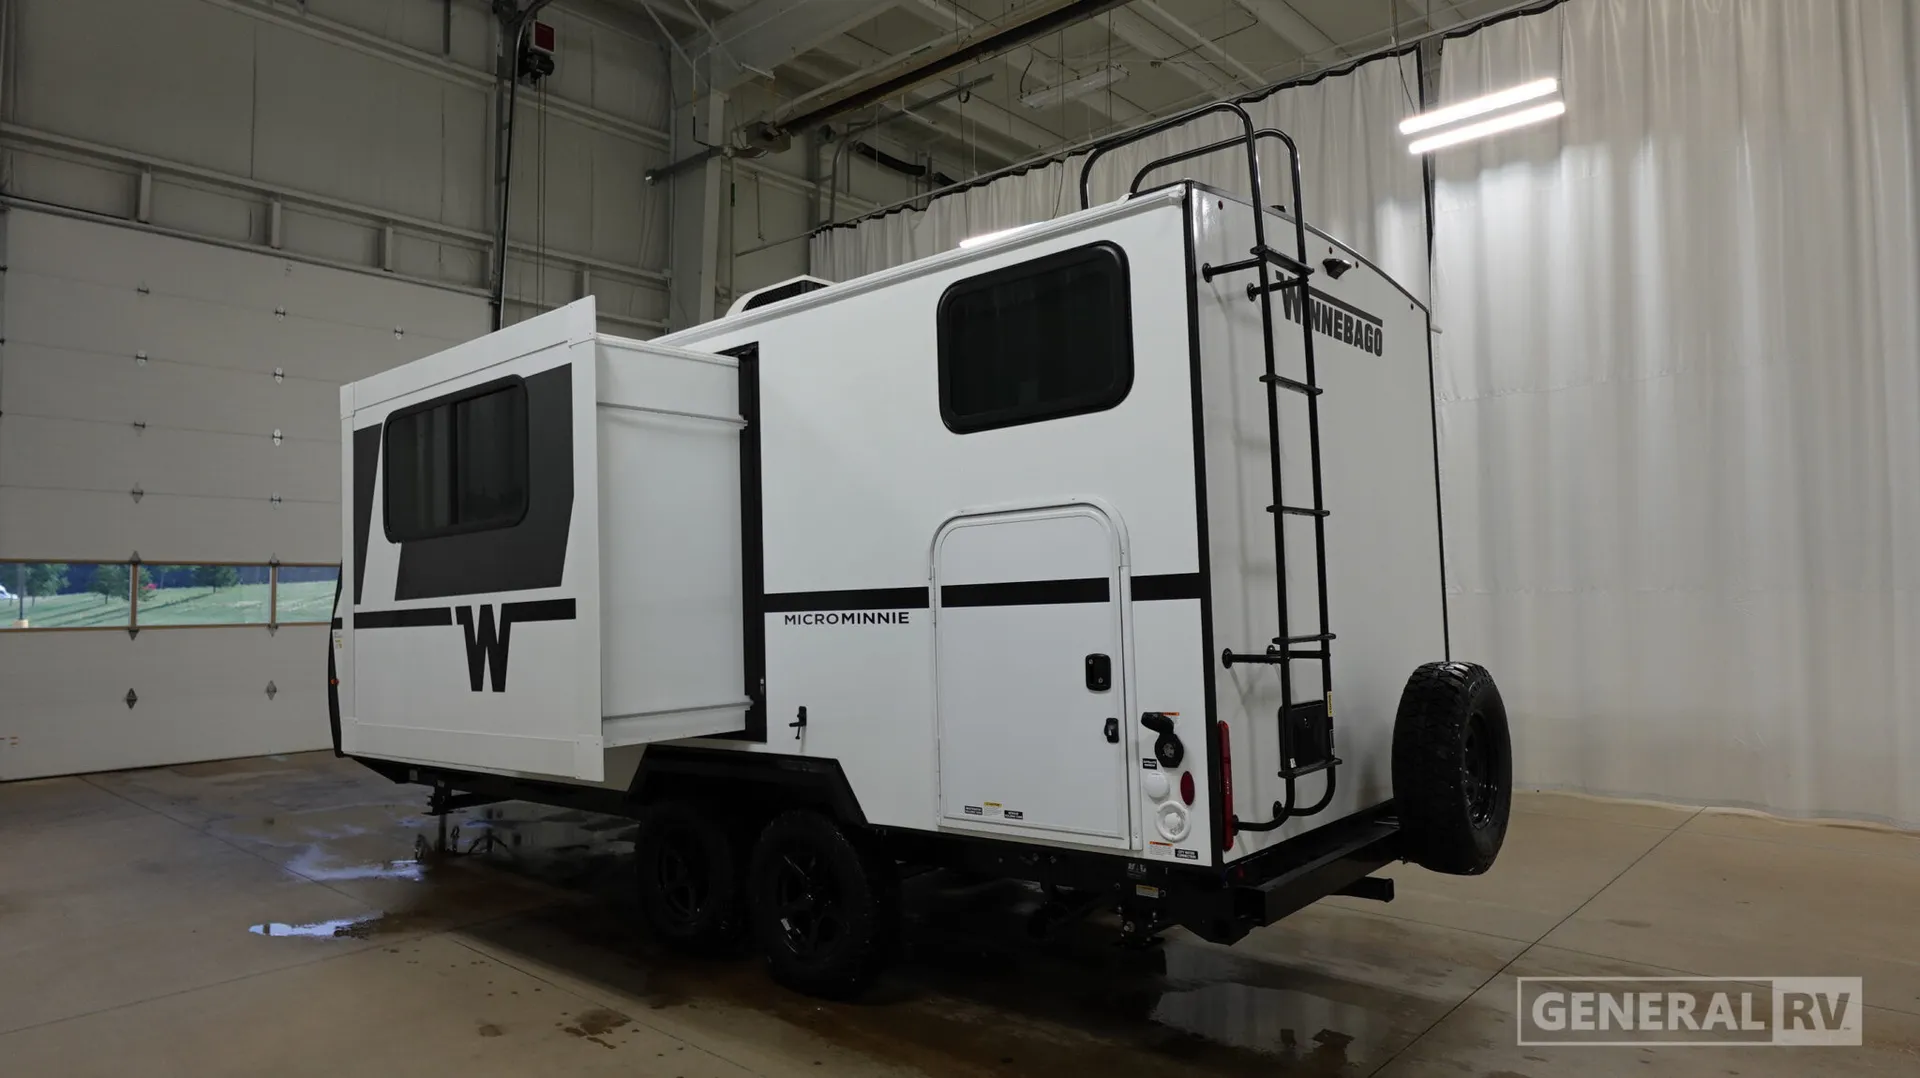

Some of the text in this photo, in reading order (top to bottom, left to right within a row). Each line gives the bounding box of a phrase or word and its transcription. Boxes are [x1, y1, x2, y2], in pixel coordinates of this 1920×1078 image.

[1275, 270, 1383, 357] WNNEBAGO
[454, 603, 512, 692] W
[784, 611, 910, 625] MICROMINNIE
